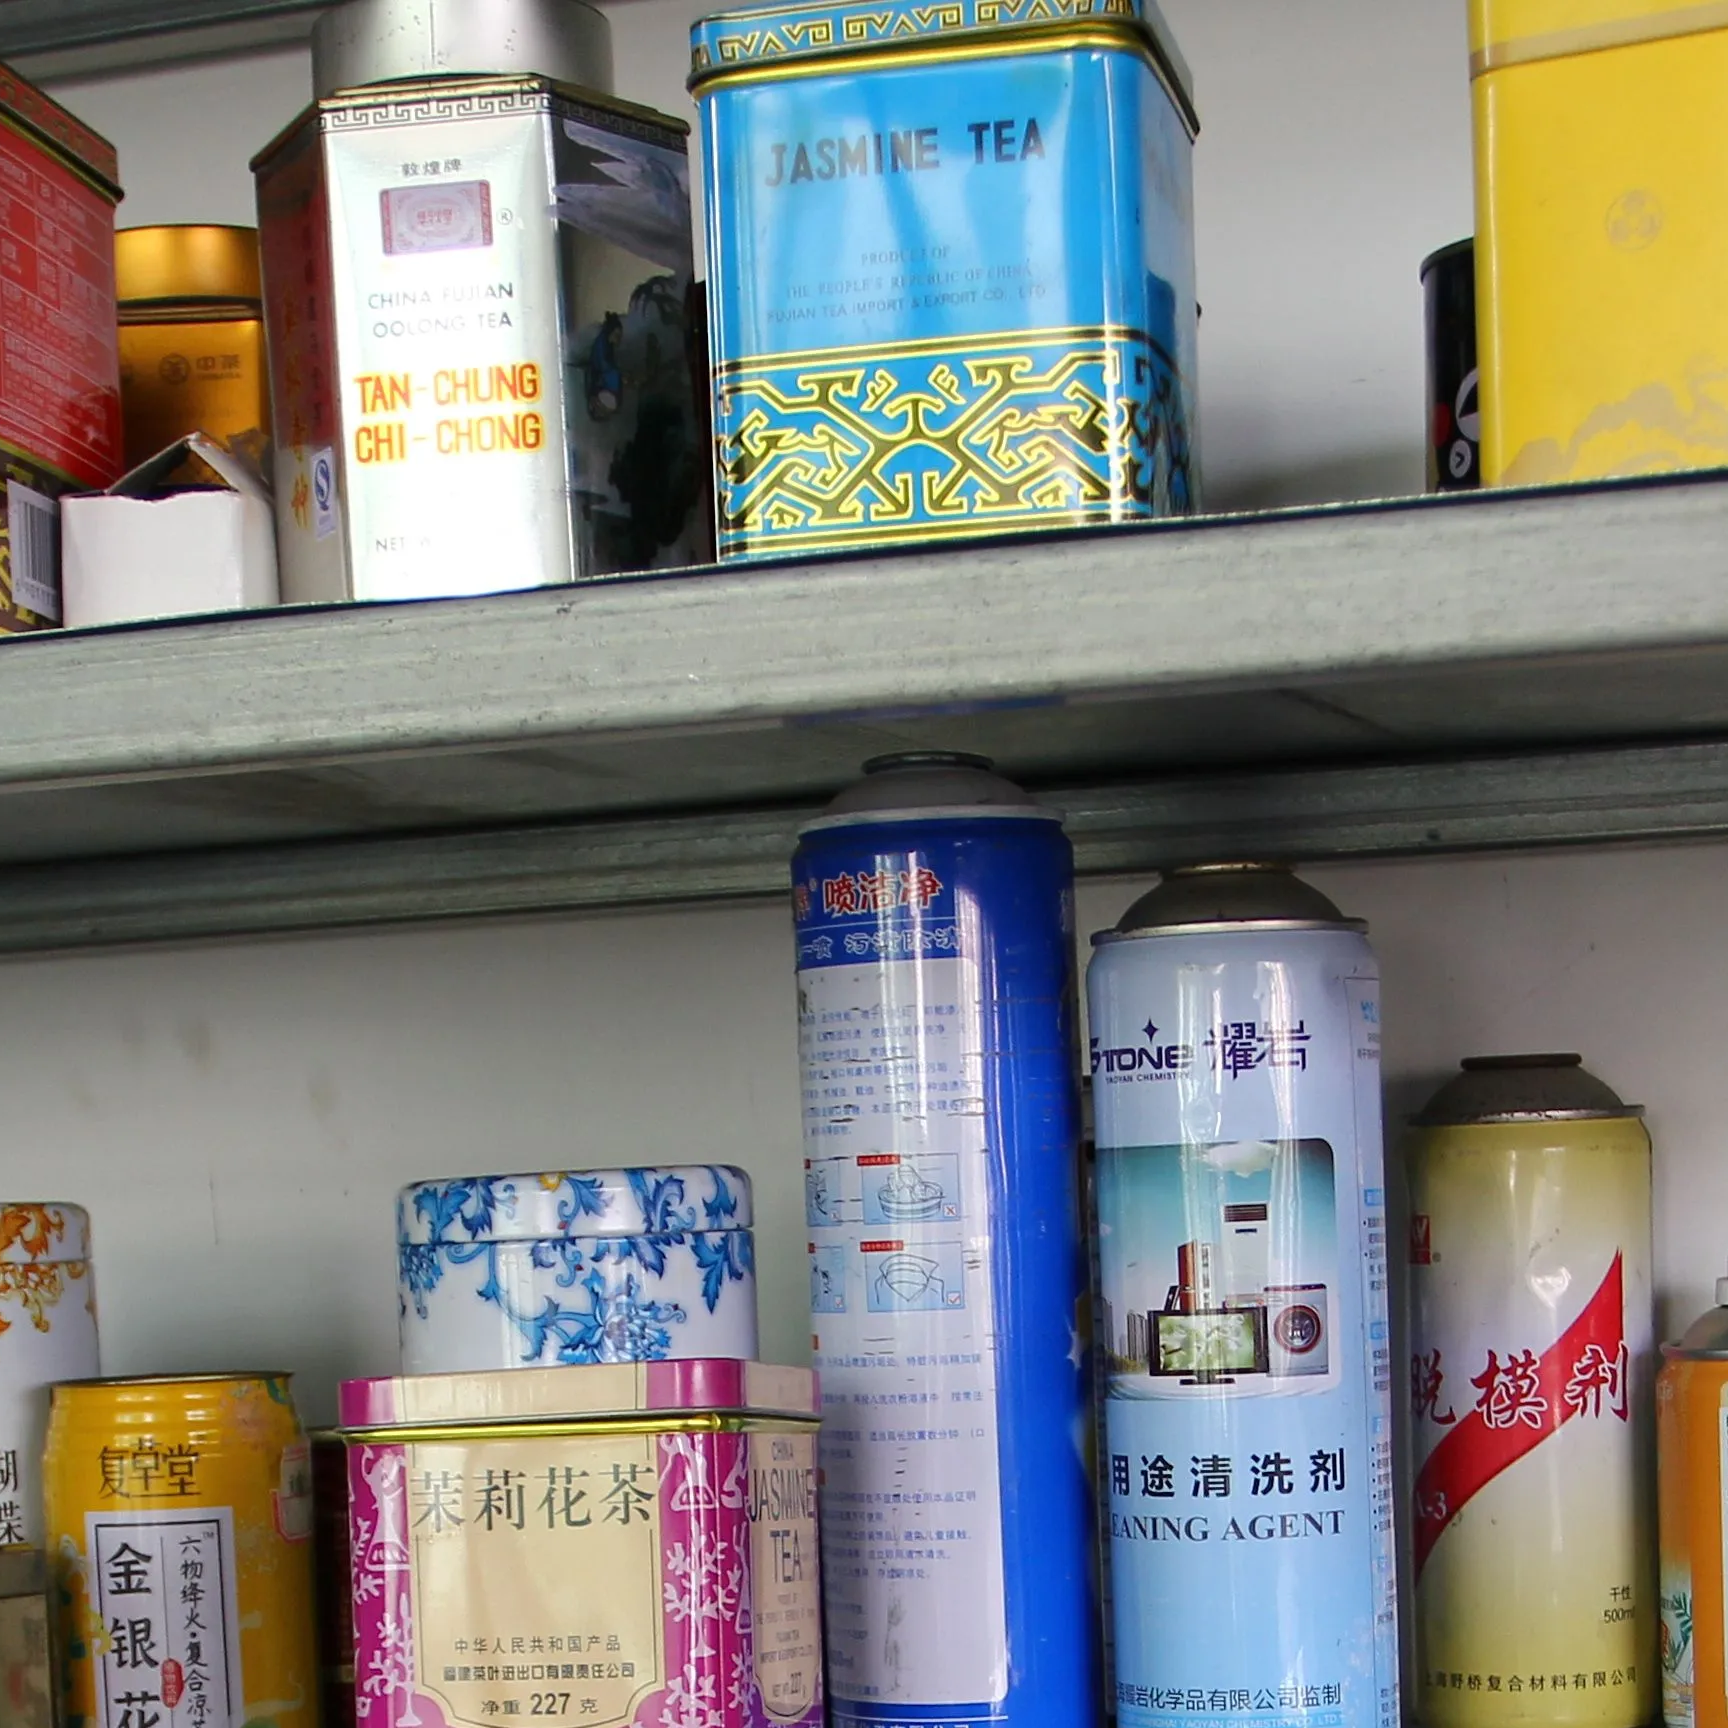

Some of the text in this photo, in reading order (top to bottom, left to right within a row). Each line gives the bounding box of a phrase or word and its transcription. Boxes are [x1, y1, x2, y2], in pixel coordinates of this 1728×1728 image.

[765, 117, 1047, 187] JASMINE TEA
[368, 286, 432, 311] CHINA
[821, 303, 848, 320] TEA
[372, 311, 514, 340] OOLONG TEA
[823, 867, 944, 918] 喷洁净
[1411, 1338, 1630, 1431] 脱模剂
[410, 1462, 657, 1533] 茉莉花茶
[749, 1467, 816, 1522] JASMINE
[1110, 1509, 1345, 1543] EANING AGENT
[769, 1529, 803, 1583] TEA
[454, 1634, 623, 1655] 中华人民共和国产品
[442, 1662, 636, 1684] 福建茶叶进出口有限责任公司
[480, 1692, 599, 1717] 净重 227 克
